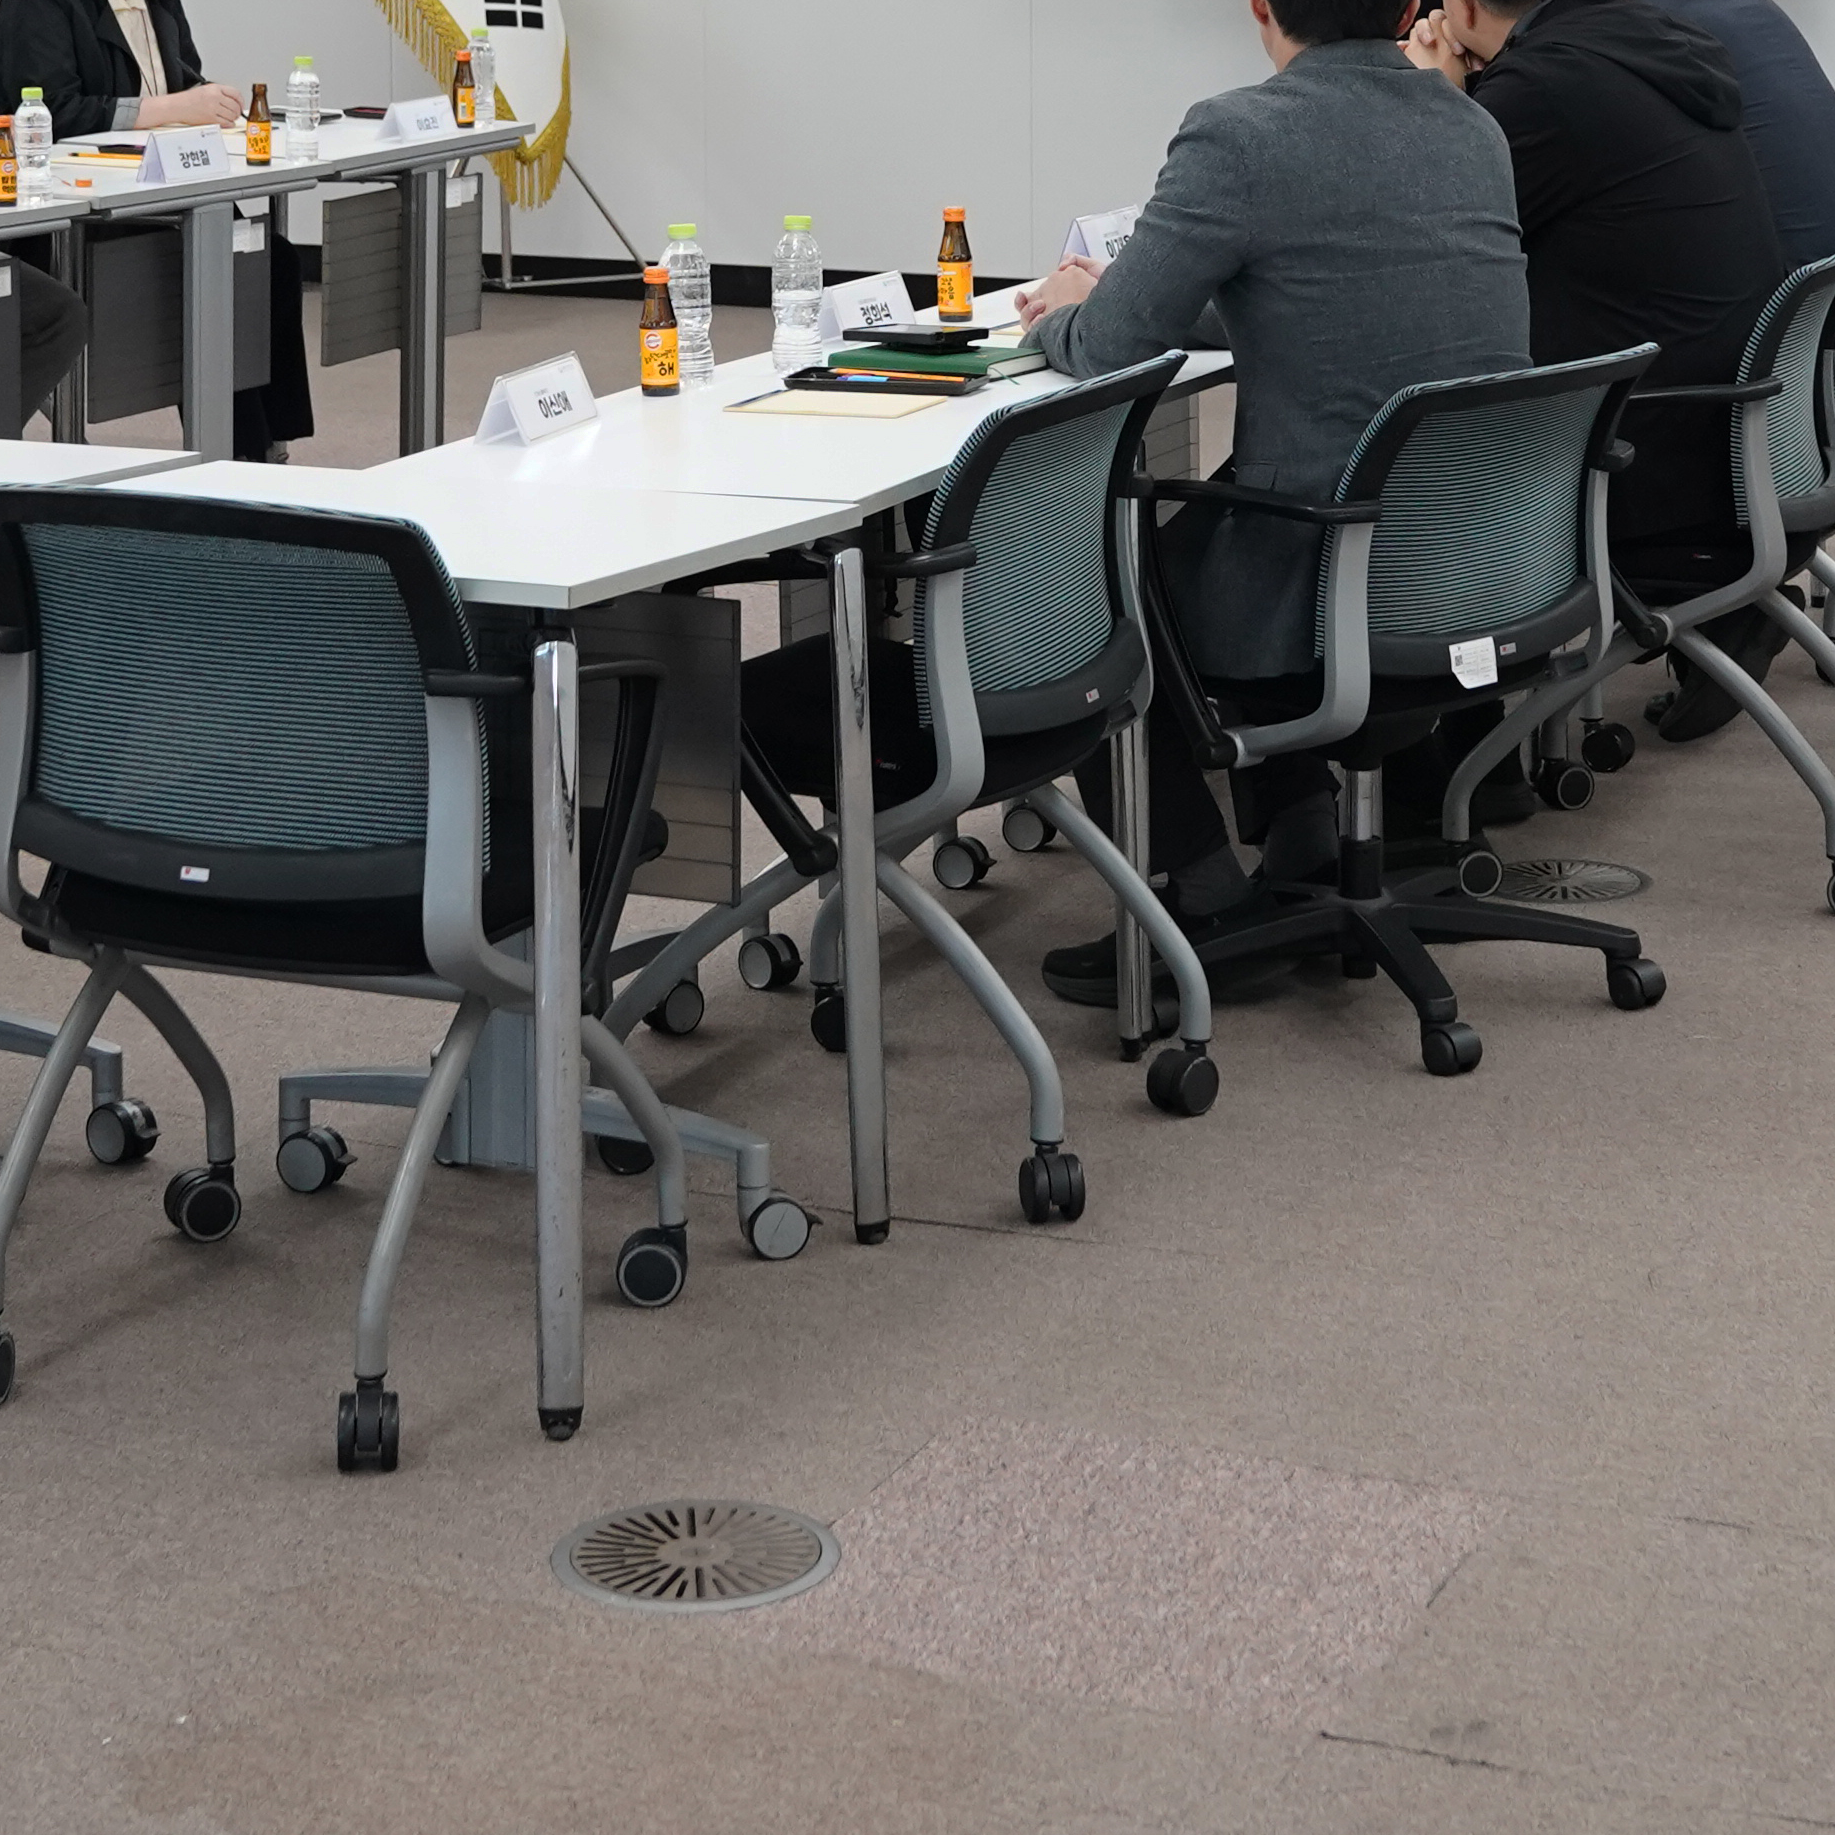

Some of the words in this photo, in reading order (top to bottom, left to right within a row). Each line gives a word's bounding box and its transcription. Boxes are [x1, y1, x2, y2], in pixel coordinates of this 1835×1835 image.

[179, 149, 211, 169] 장현철
[859, 300, 893, 326] 정희석
[657, 361, 675, 377] 해
